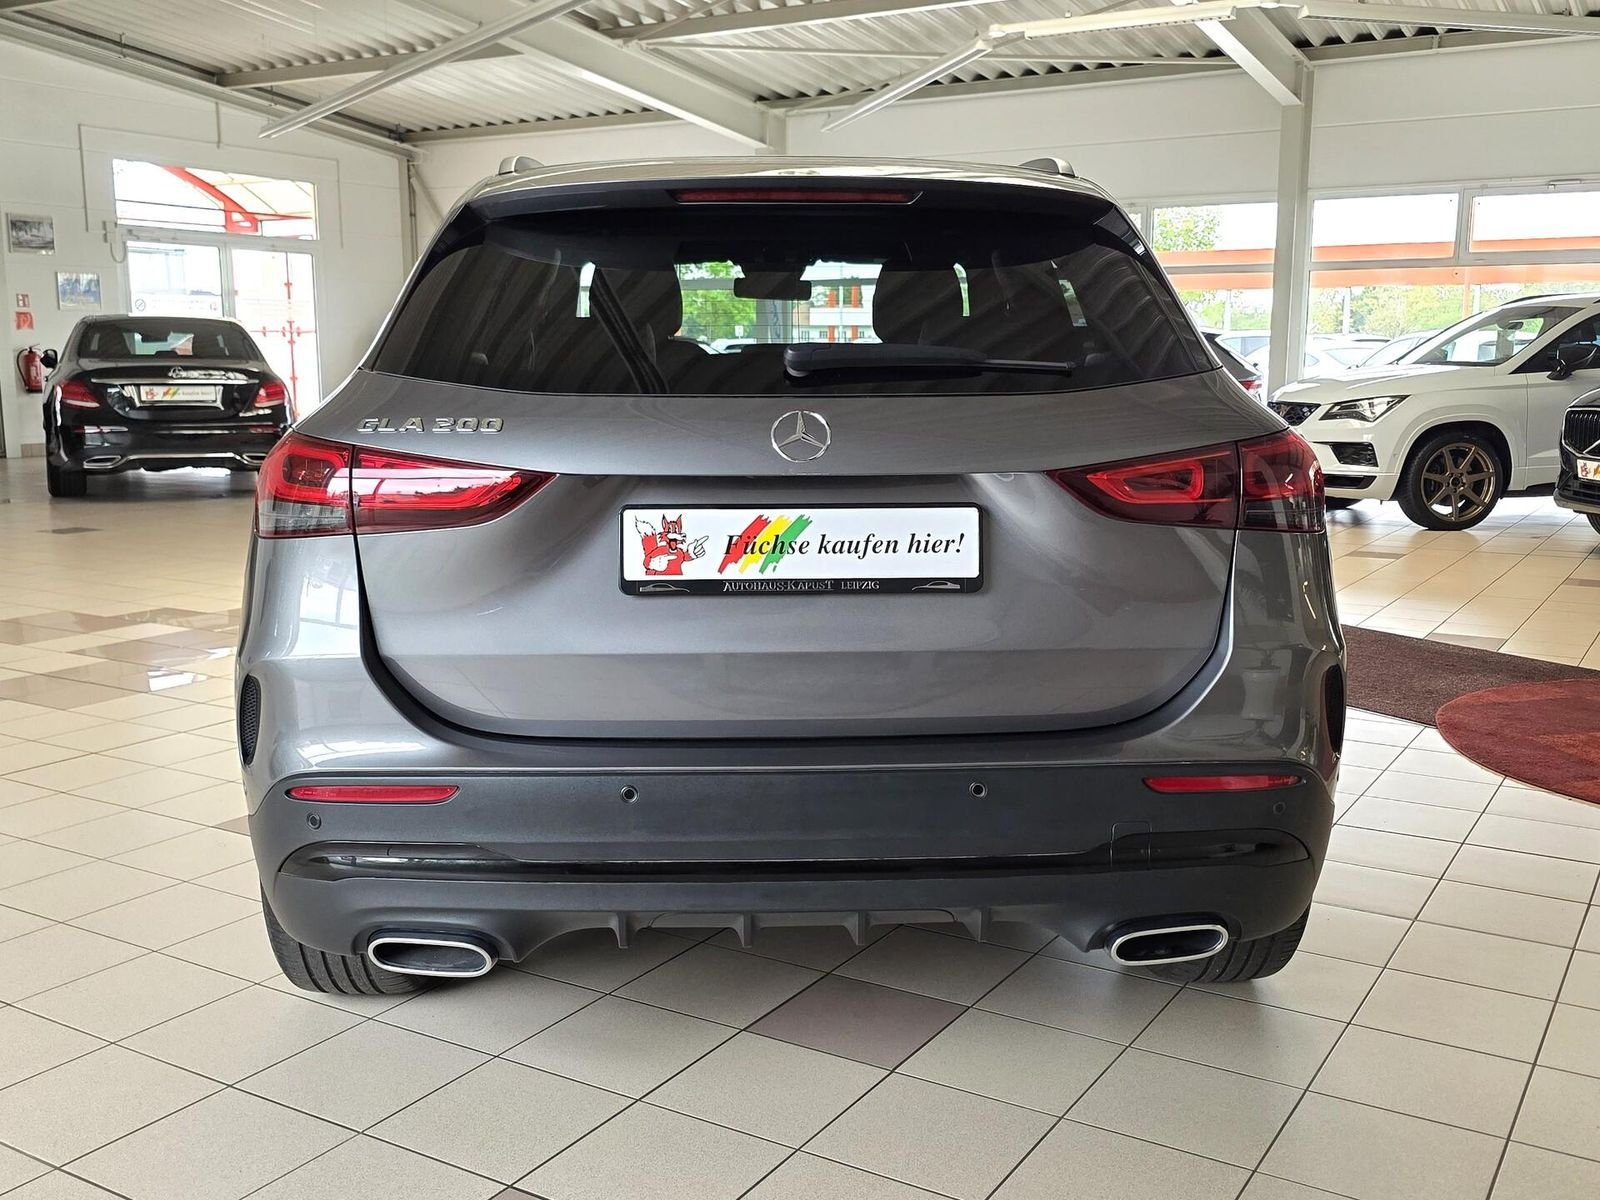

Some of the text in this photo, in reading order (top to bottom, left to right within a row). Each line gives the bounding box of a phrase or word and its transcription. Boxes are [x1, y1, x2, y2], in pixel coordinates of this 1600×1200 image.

[356, 417, 504, 434] GLA 200
[724, 532, 965, 560] Füchse kaufen hier!
[841, 580, 880, 590] LEIPZIG
